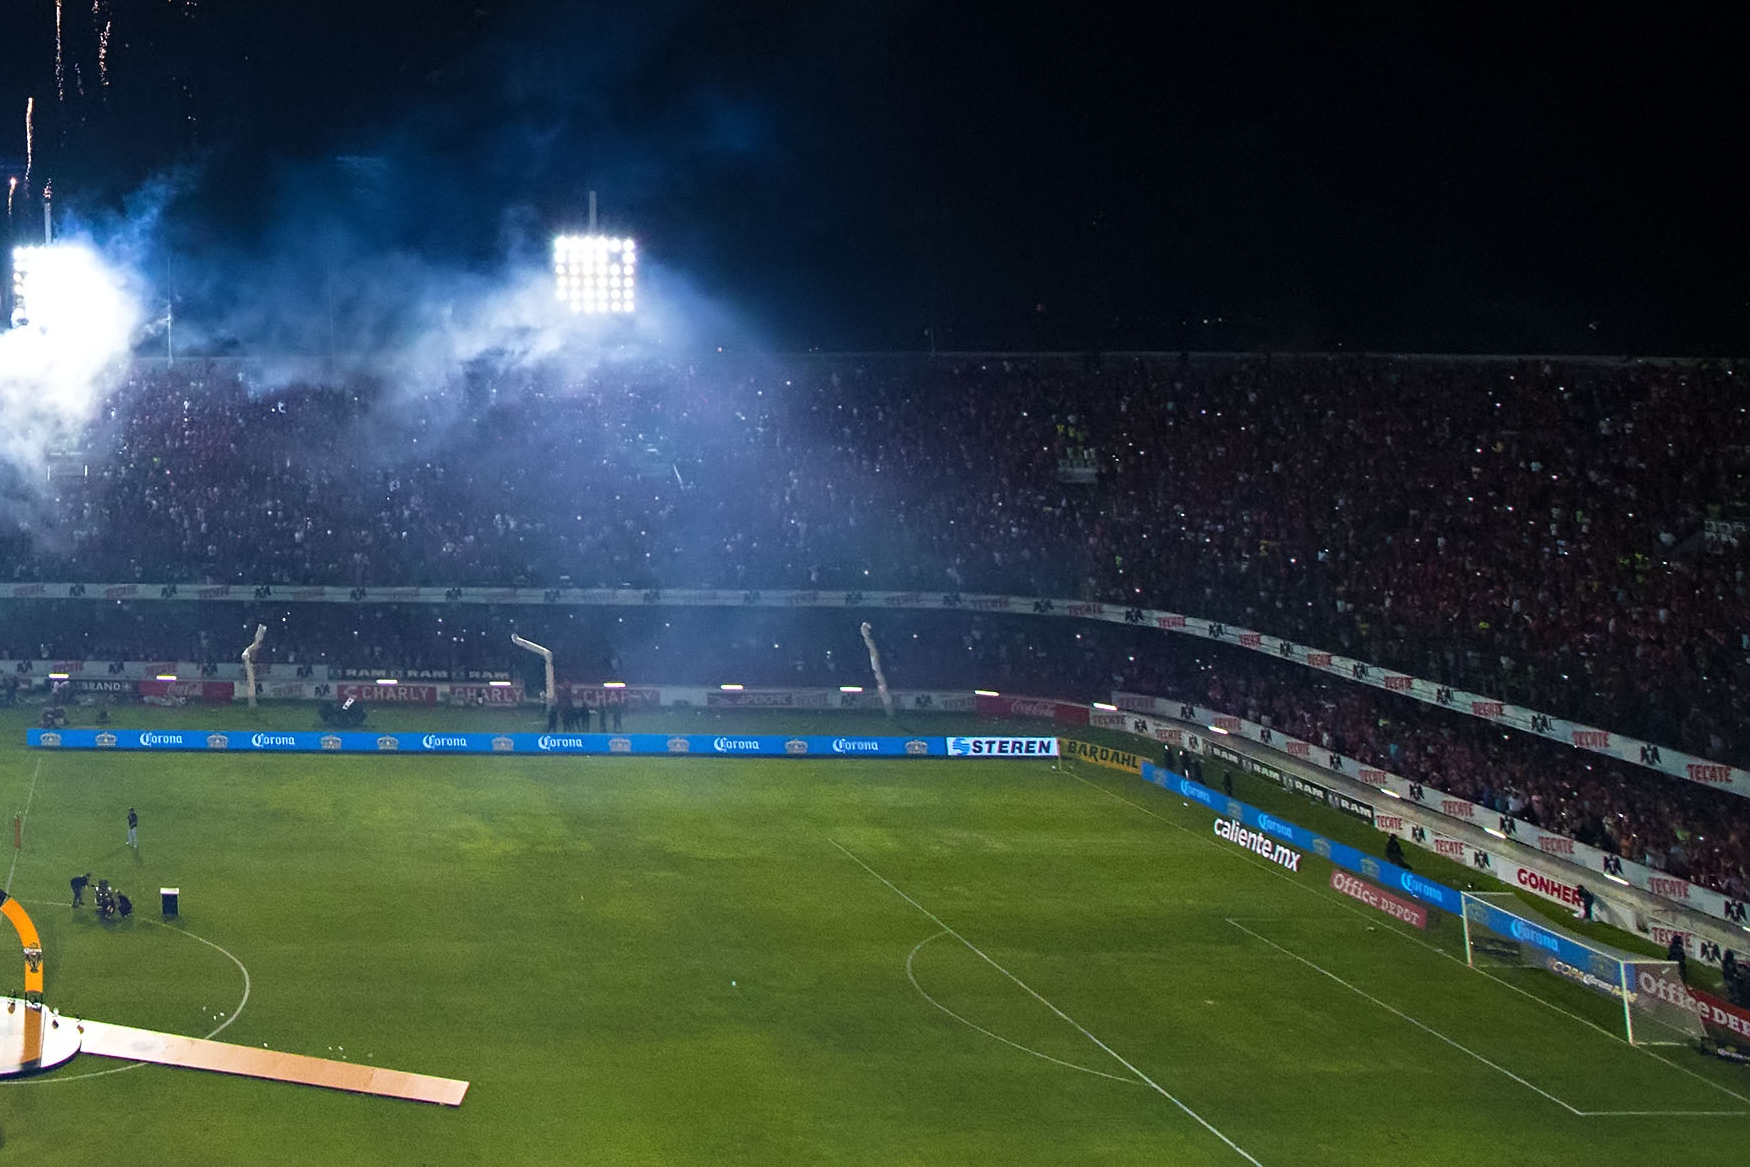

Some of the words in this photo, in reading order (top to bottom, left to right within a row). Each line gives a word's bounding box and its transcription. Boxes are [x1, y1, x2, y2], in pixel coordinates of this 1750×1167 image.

[362, 685, 430, 701] CHARLY
[139, 732, 183, 748] Corona
[251, 732, 296, 748] Corona
[422, 734, 468, 749] Corona
[537, 735, 584, 750] Corona
[713, 736, 760, 752] Corona
[832, 738, 879, 754] Corona
[971, 740, 1052, 755] STEREN
[1571, 730, 1610, 749] TECATE
[1067, 740, 1139, 769] BARDAHL
[1253, 764, 1281, 782] RAM
[1687, 763, 1732, 784] TECATE
[1295, 781, 1325, 800] RAM
[1340, 798, 1372, 818] RAM
[1442, 799, 1474, 818] TECATE
[1257, 813, 1293, 839] Corona
[1376, 815, 1403, 831] TECATE
[1213, 816, 1302, 873] caliente.mx
[1434, 838, 1465, 856] TECATE
[1538, 835, 1575, 855] TECATE
[1401, 872, 1443, 903] Corona
[1517, 867, 1584, 908] GONHER
[1648, 876, 1691, 899] TECATE
[1333, 872, 1378, 907] Office
[1378, 900, 1420, 925] DEPOT
[1511, 917, 1560, 953] Corona
[1639, 972, 1710, 1019] Office
